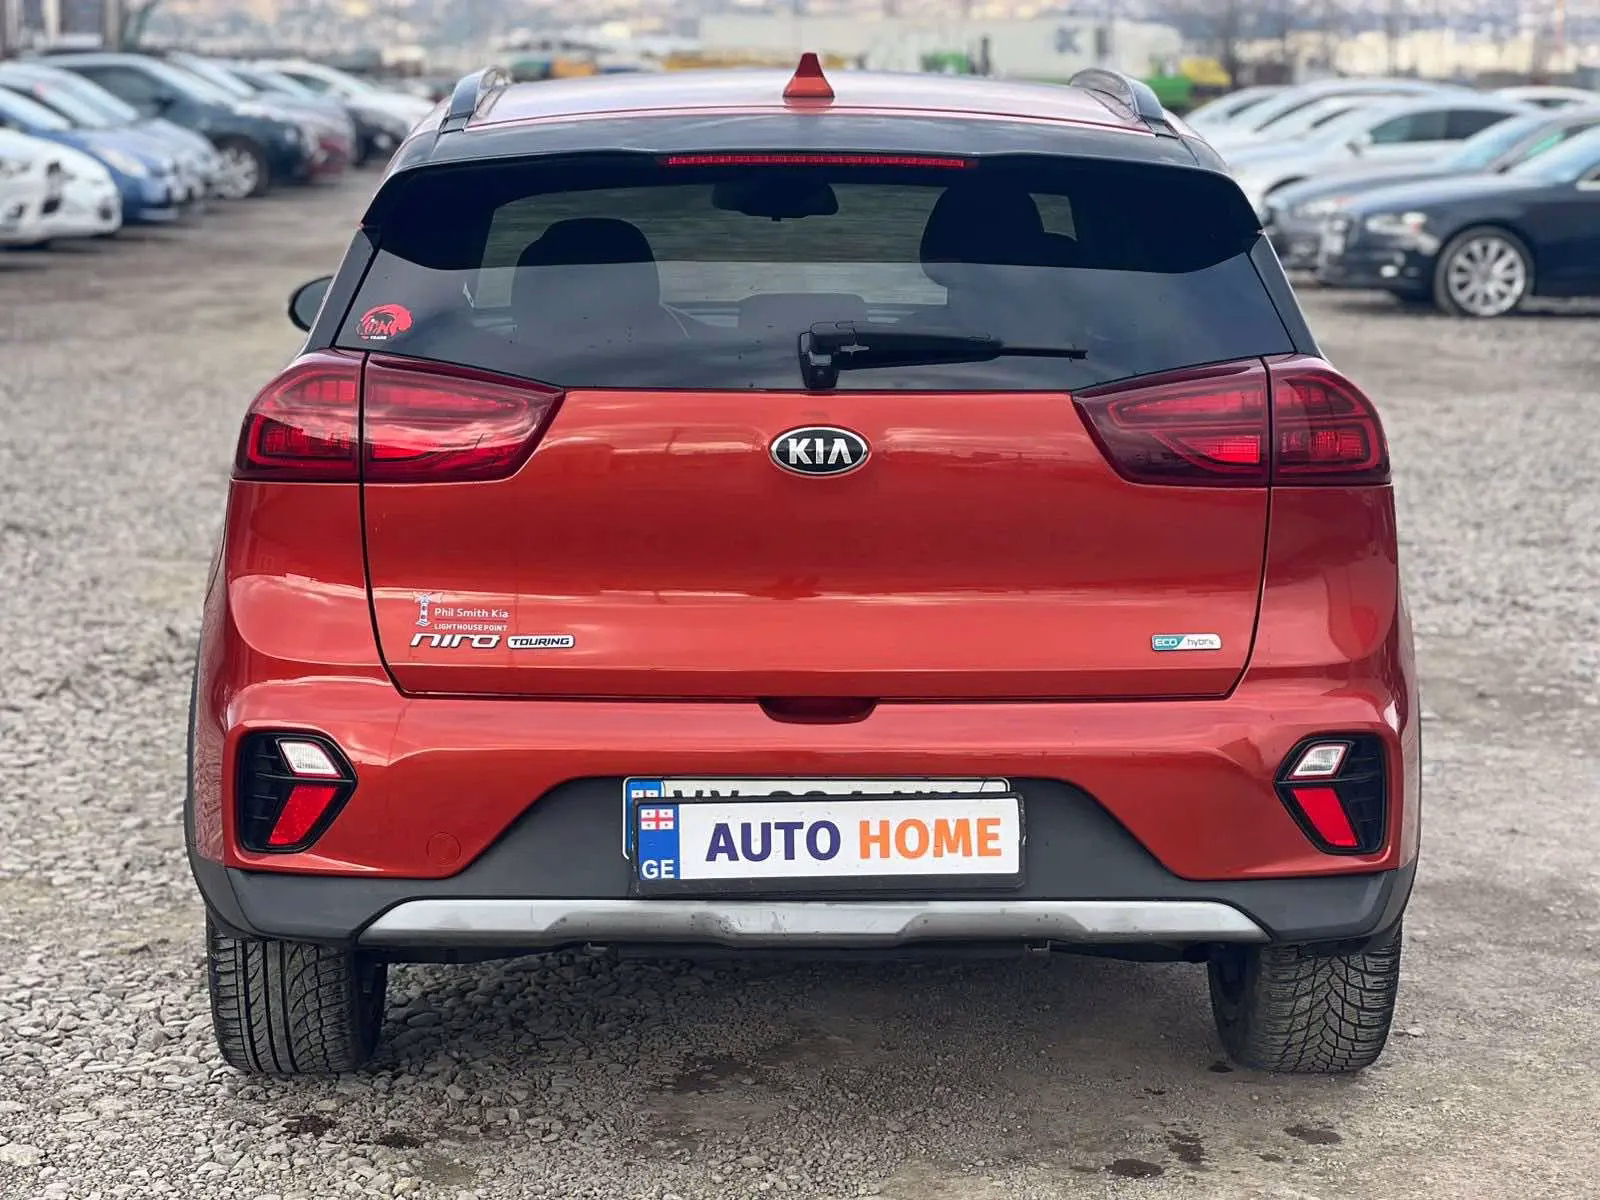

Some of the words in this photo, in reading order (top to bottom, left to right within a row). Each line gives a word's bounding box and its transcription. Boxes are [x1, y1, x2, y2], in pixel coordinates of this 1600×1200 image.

[787, 438, 853, 465] KIA
[434, 607, 454, 617] Phil
[456, 608, 488, 618] Smith
[491, 609, 509, 618] Kia
[511, 638, 571, 646] TOURING
[1155, 638, 1178, 647] ECO
[705, 820, 841, 862] AUTO
[858, 818, 1003, 860] HOME
[641, 859, 675, 879] GE
